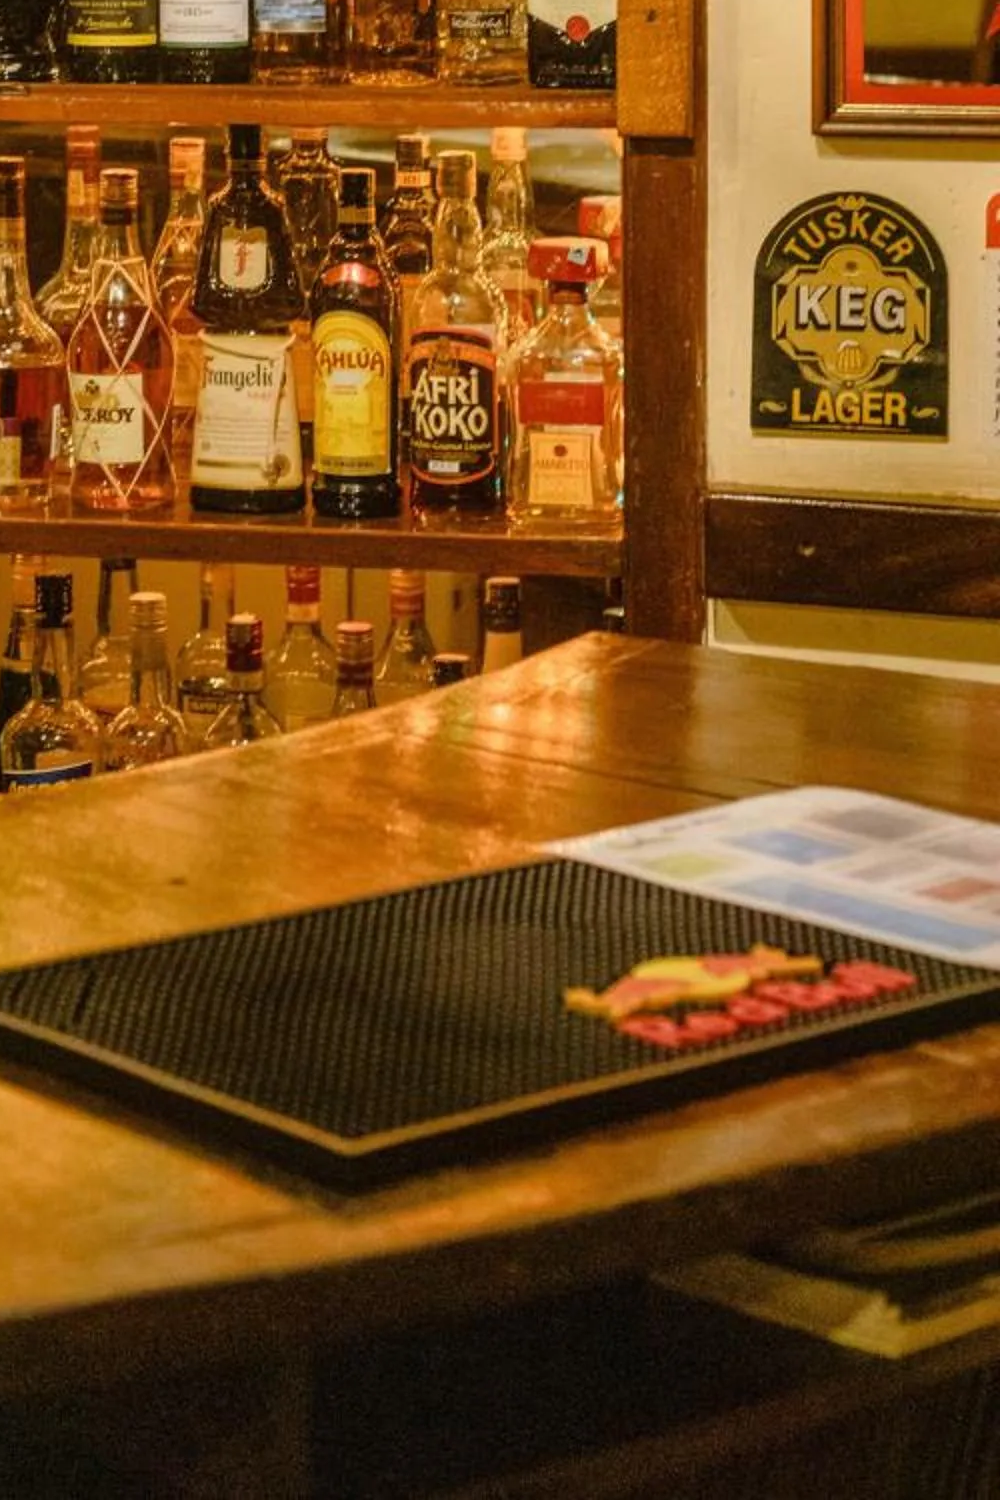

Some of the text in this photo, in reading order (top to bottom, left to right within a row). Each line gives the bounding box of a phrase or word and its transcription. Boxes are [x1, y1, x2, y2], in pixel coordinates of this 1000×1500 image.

[784, 211, 915, 263] TUSKER
[796, 284, 906, 333] KEG
[415, 403, 489, 441] KOKO
[791, 387, 908, 427] LAGER
